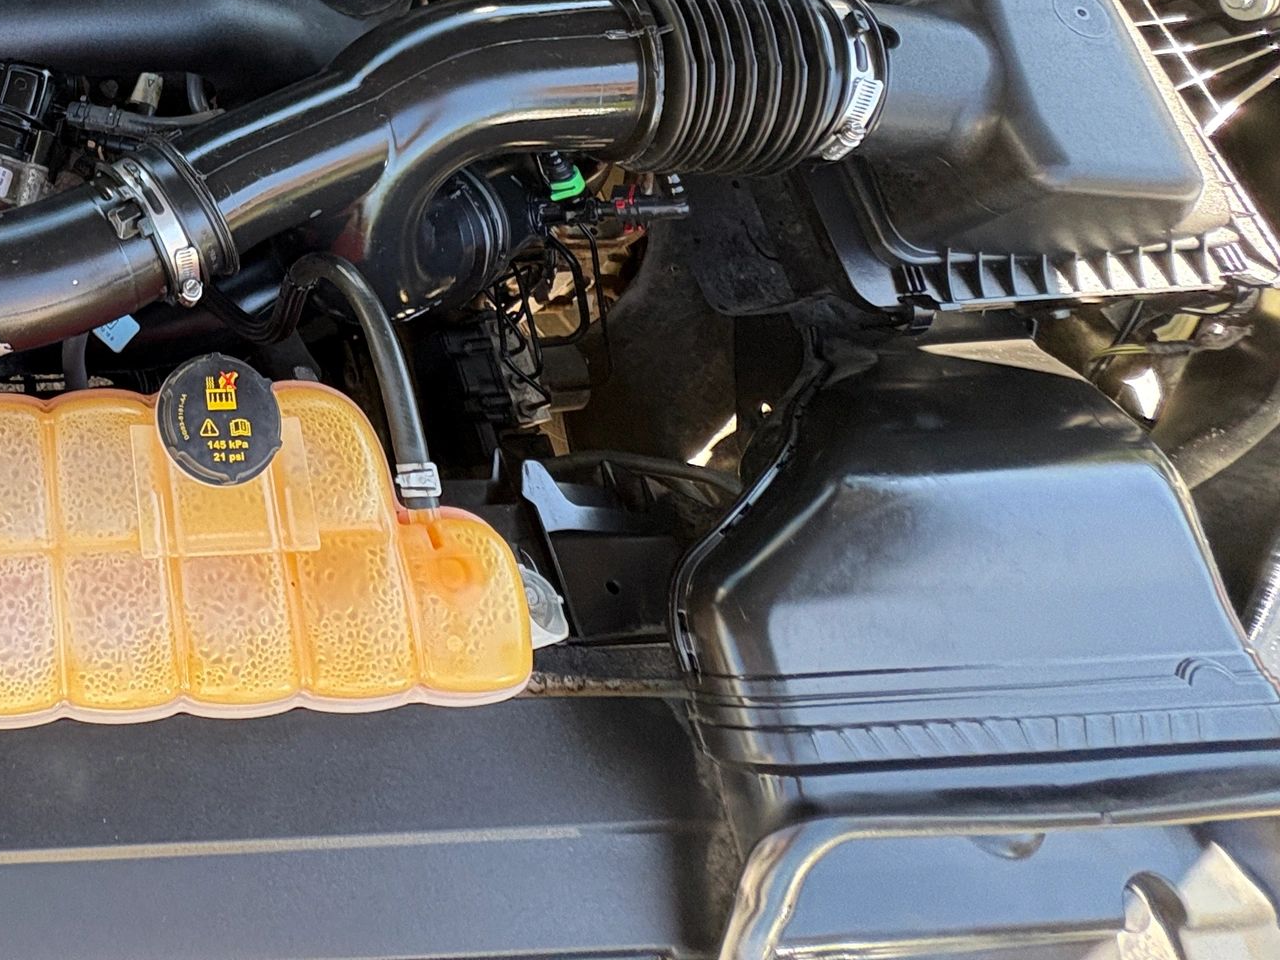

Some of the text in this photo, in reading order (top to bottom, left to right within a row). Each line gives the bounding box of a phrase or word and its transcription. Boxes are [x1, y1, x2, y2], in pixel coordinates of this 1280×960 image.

[207, 440, 249, 450] 145 kPa
[213, 451, 245, 463] 21 psi
